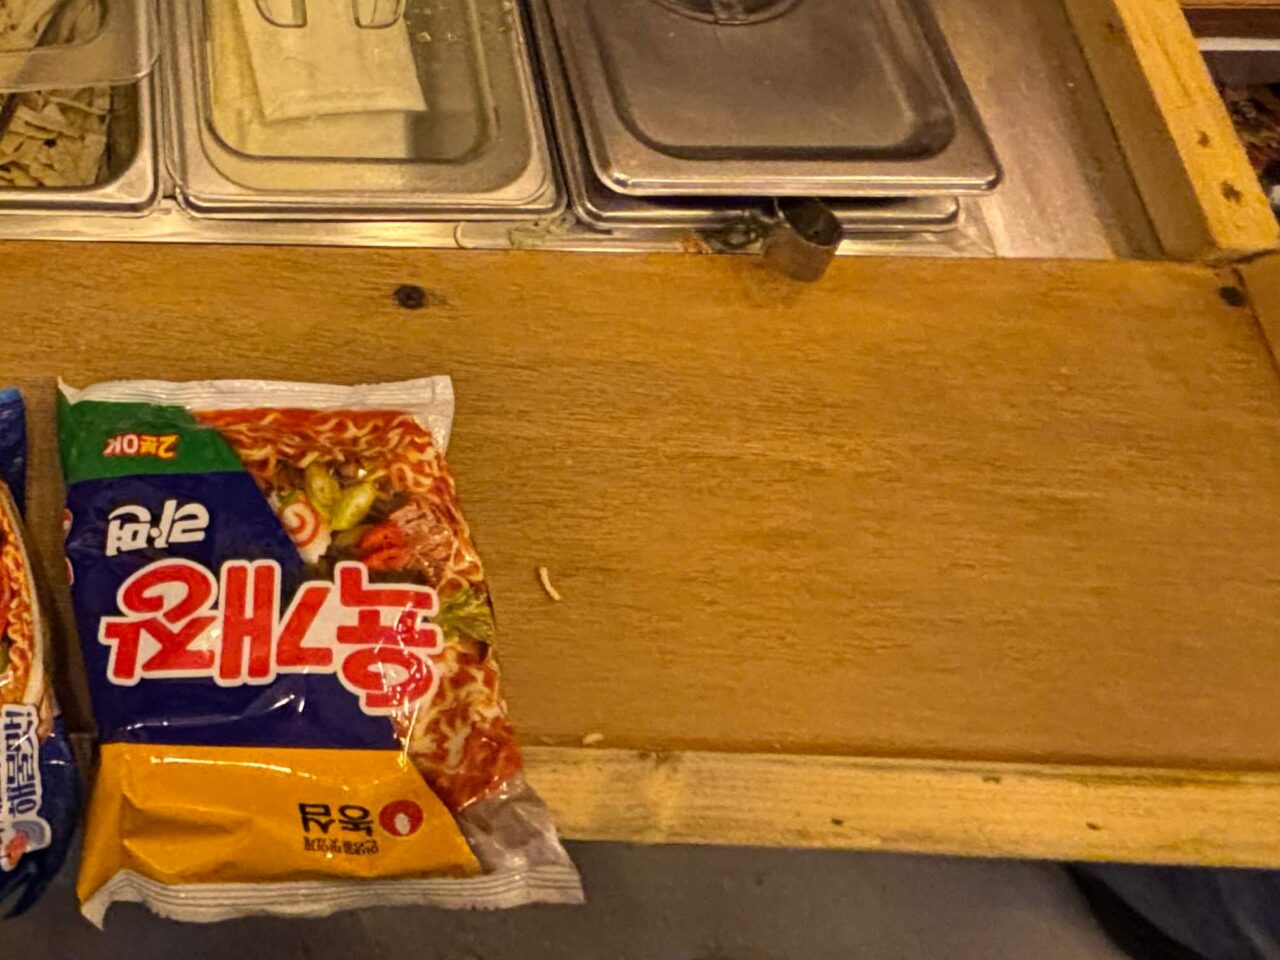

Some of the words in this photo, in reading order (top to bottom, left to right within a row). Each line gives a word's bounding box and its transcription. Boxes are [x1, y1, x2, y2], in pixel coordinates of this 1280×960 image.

[105, 499, 210, 557] 라면
[100, 559, 441, 716] 육개장
[299, 803, 375, 835] 농심
